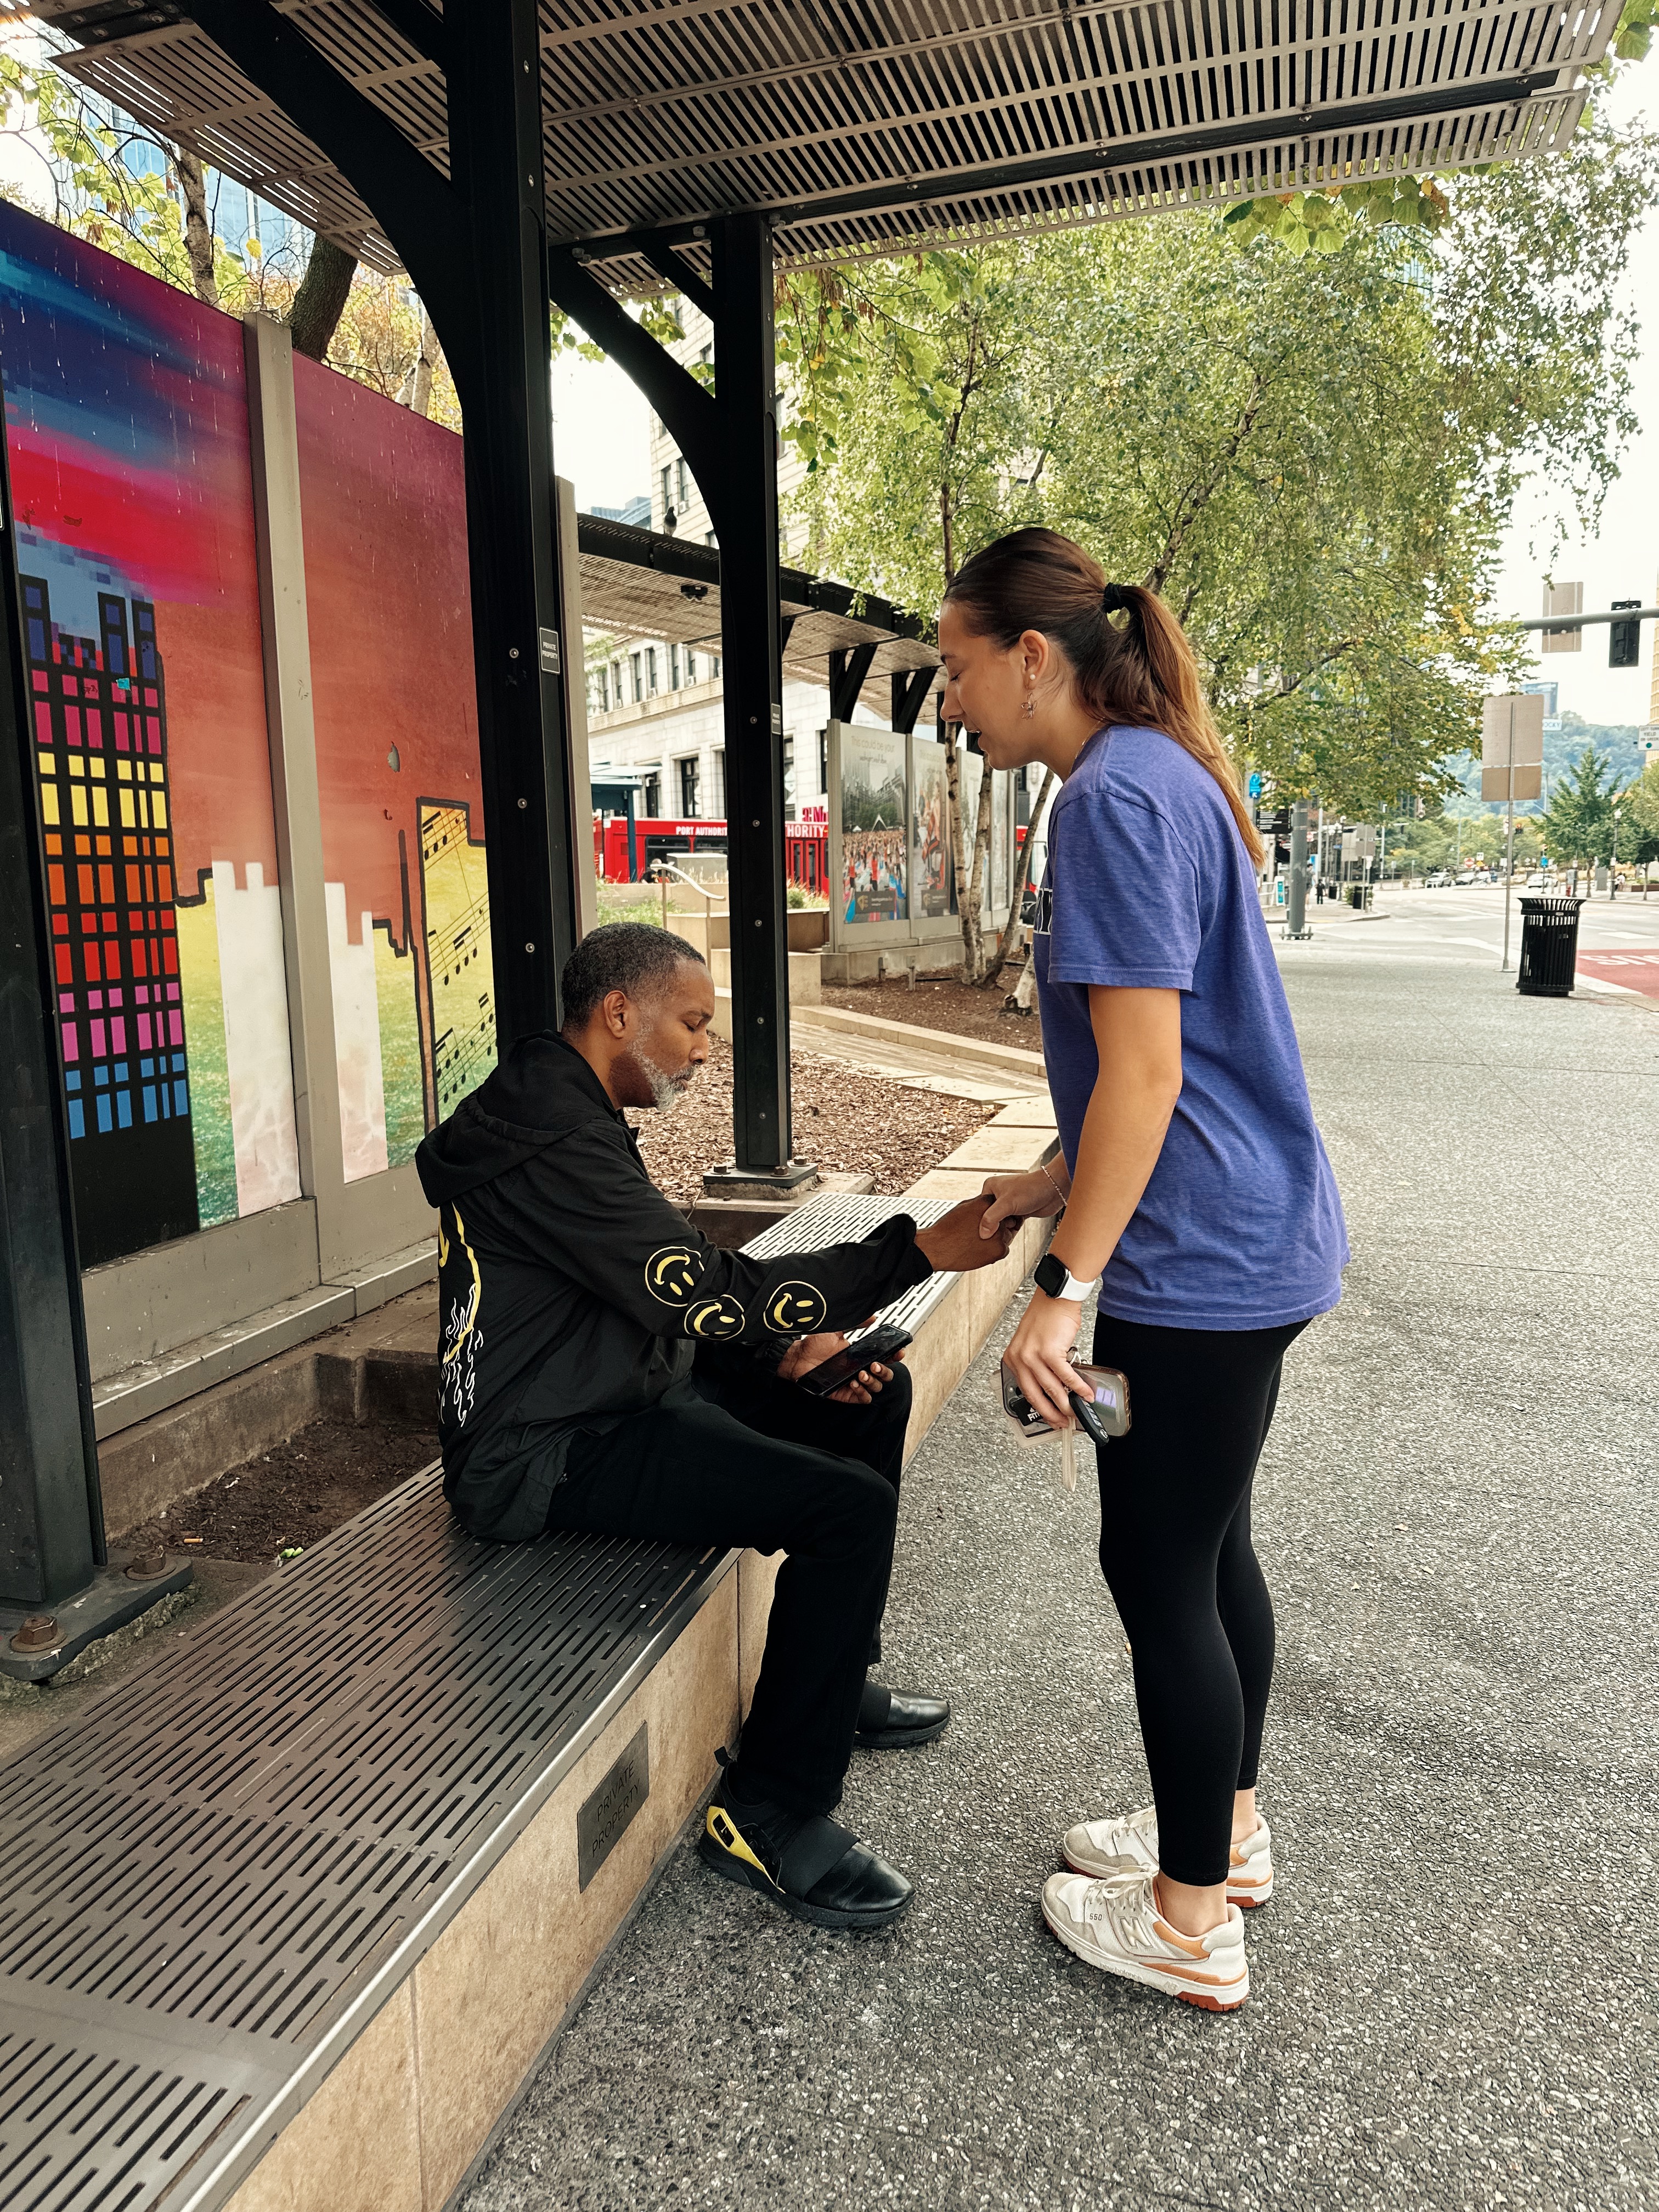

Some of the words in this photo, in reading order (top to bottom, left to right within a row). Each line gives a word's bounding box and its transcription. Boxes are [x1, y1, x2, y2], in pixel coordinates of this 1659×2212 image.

[676, 826, 695, 835] PORT
[695, 827, 727, 836] AUTHORIT
[785, 825, 825, 838] HORITY
[597, 1759, 634, 1822] PRIVATE
[592, 1778, 640, 1858] PROPERTY
